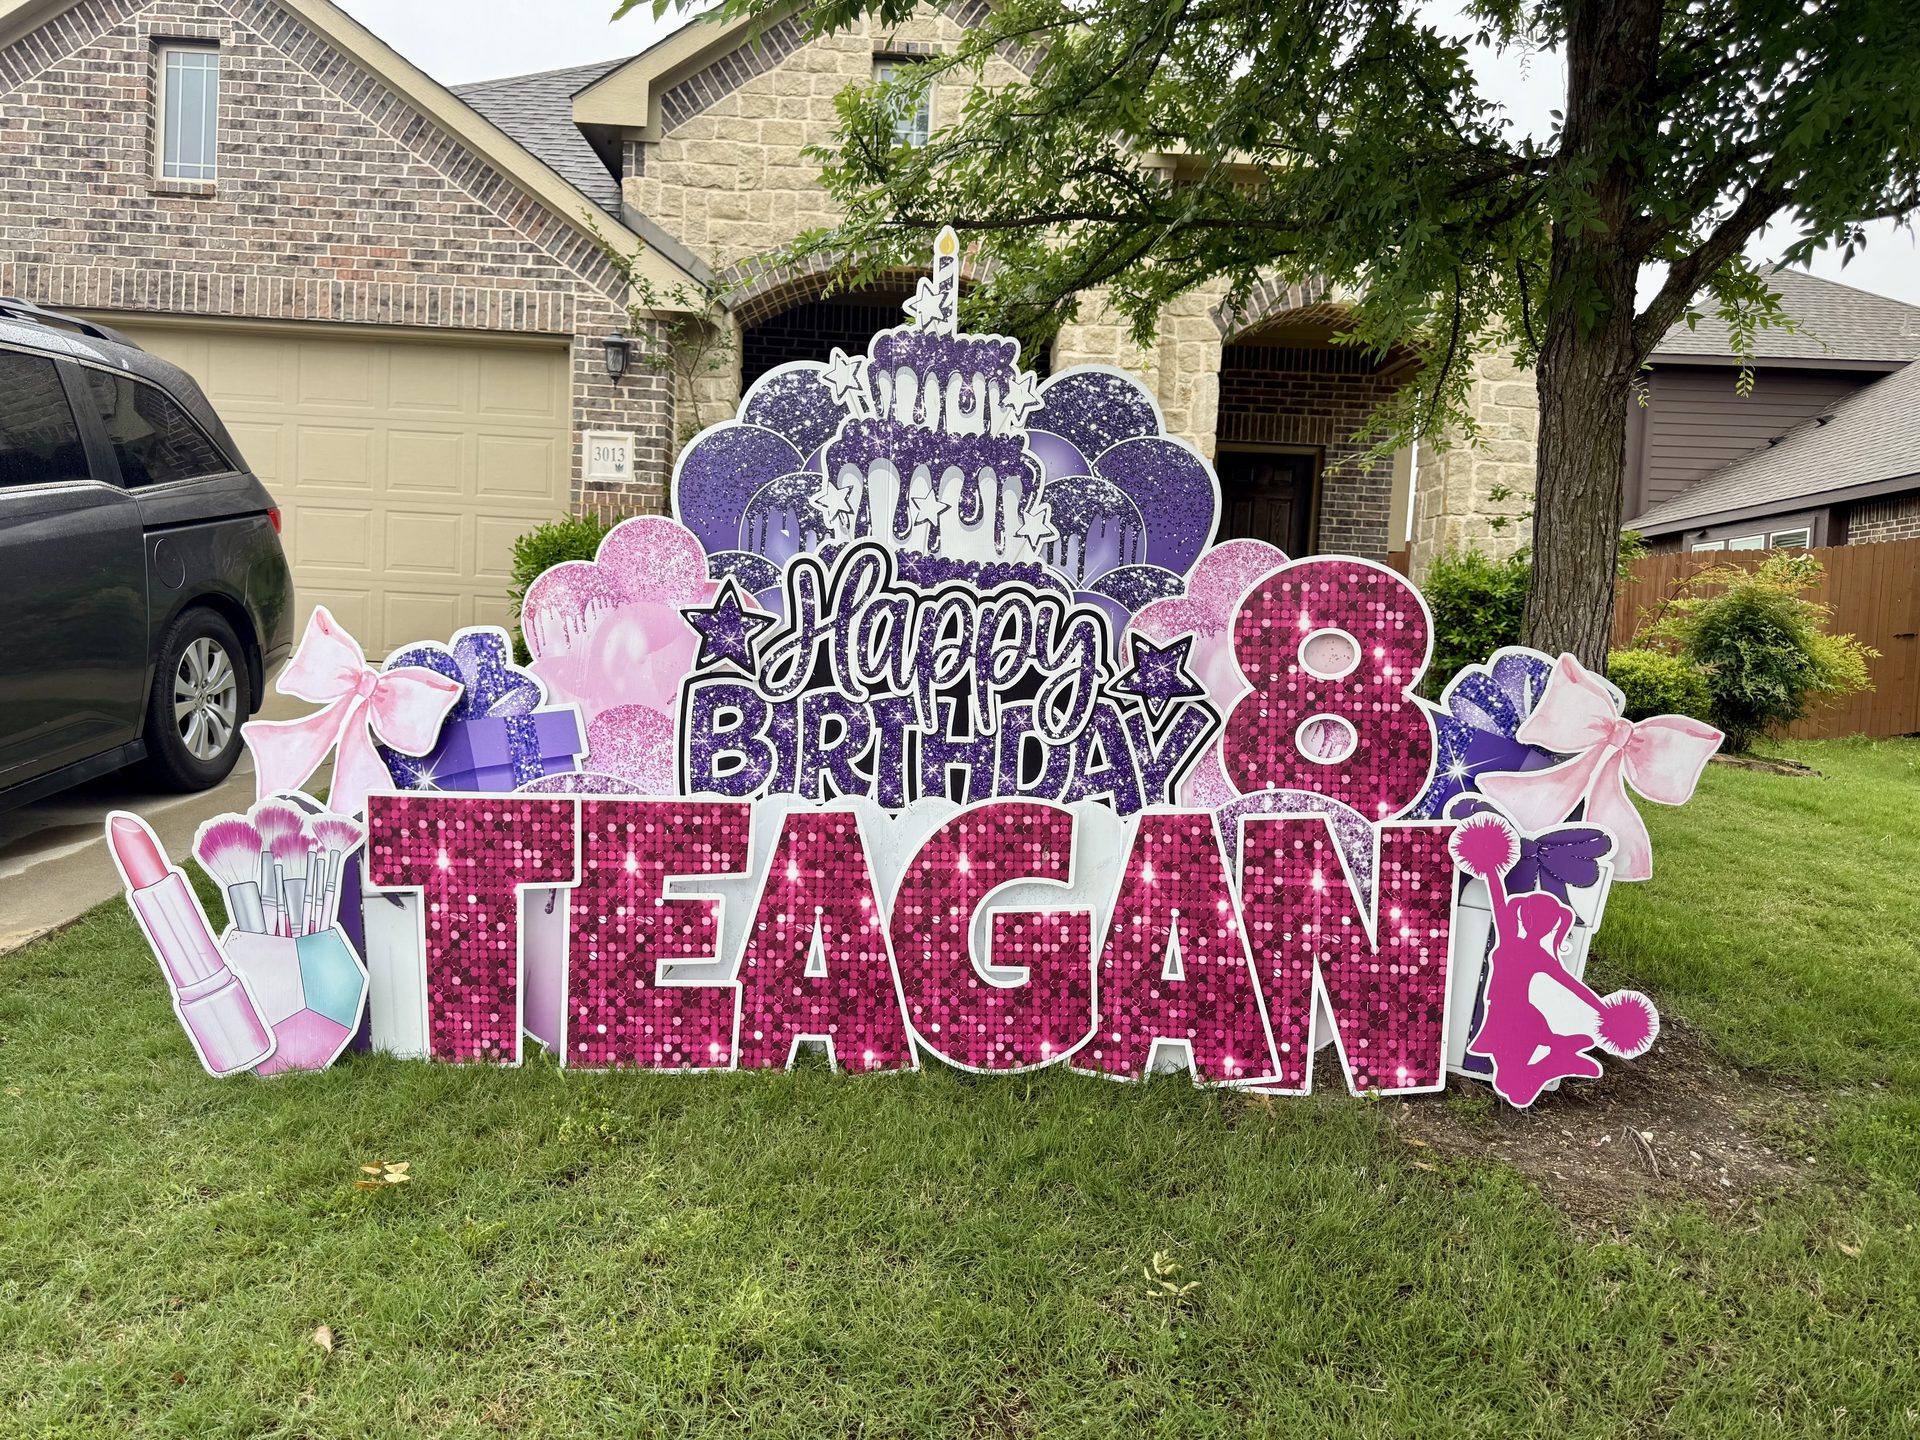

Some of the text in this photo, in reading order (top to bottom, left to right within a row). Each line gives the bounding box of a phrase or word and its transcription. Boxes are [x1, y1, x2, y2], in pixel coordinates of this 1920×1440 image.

[594, 446, 625, 462] 3013
[760, 546, 1108, 740] Happy
[1219, 556, 1436, 821] 8
[686, 681, 1213, 817] BIRTHDAY
[367, 790, 1459, 1096] TEAGAN
